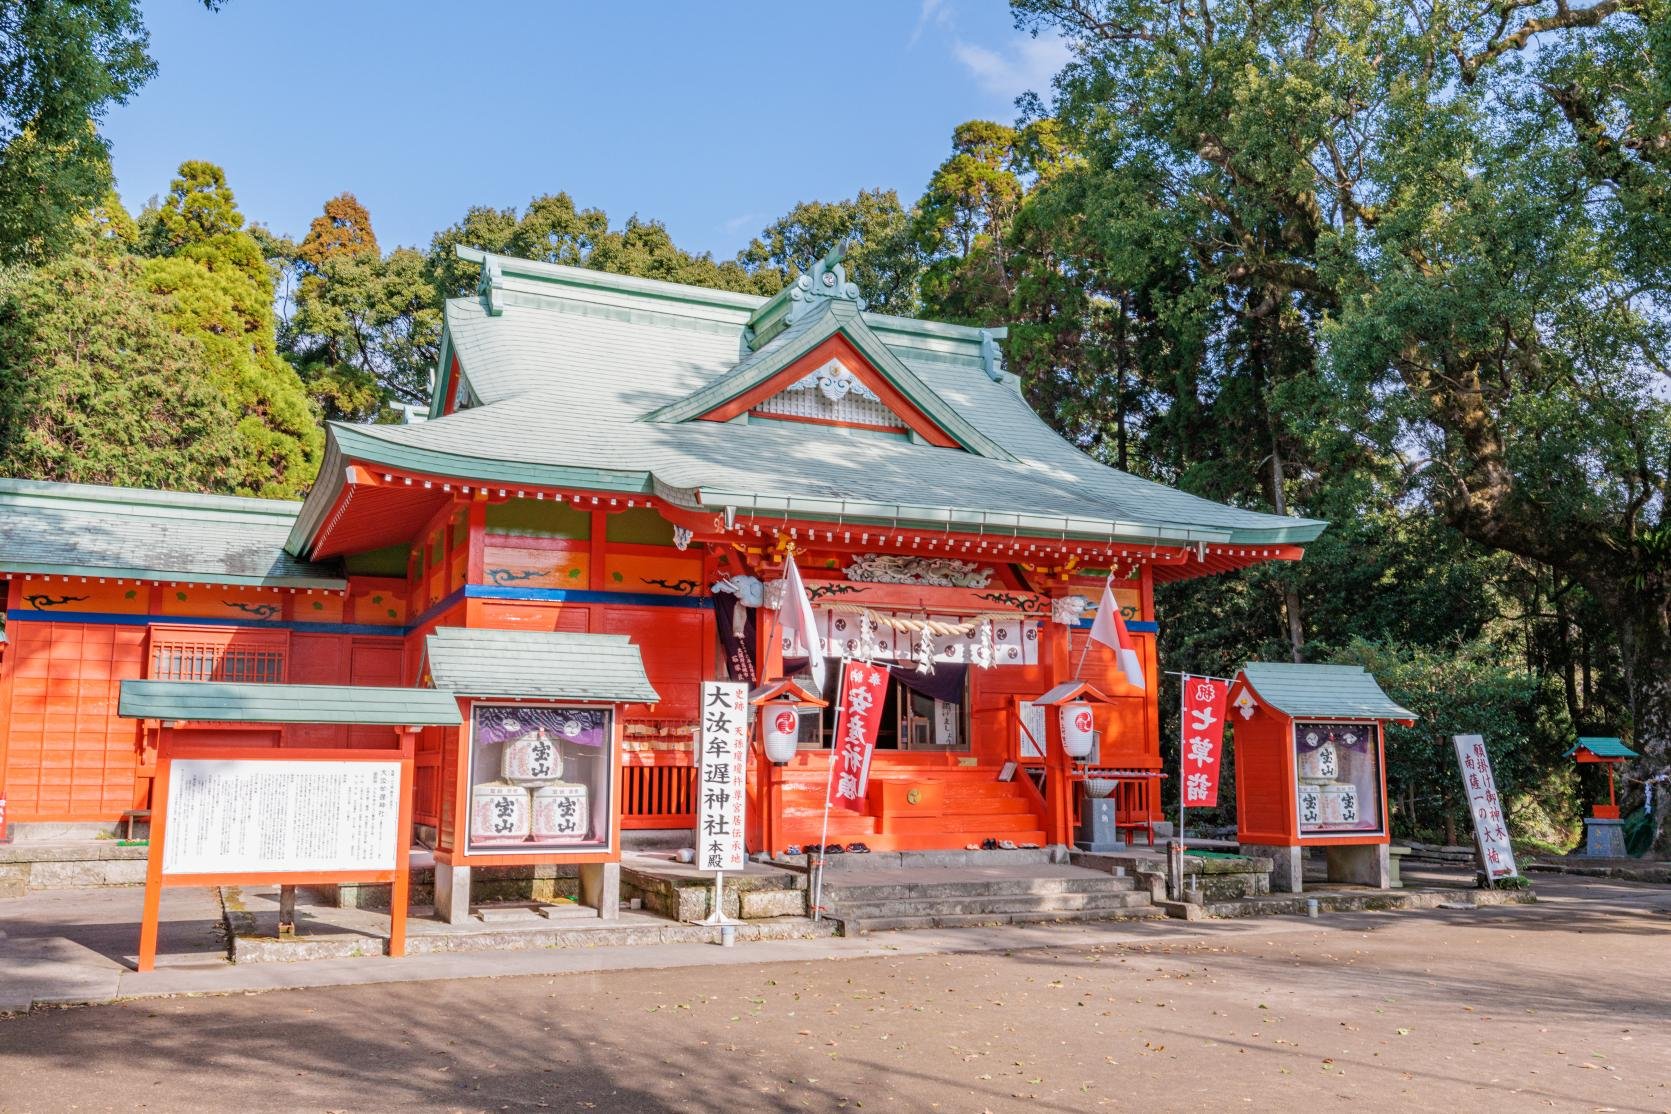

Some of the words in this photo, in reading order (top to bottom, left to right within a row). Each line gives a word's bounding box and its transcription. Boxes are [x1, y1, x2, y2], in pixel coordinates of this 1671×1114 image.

[734, 688, 745, 712] 史跡
[531, 741, 551, 777] 宝山
[1319, 748, 1334, 776] 宝山
[1302, 793, 1317, 822] 宝山
[1341, 792, 1355, 821] 宝山
[1464, 753, 1500, 865] 南薩一の大楠
[1473, 743, 1507, 841] 願掛け御神木
[494, 797, 514, 833] 宝山
[557, 797, 576, 833] 宝山
